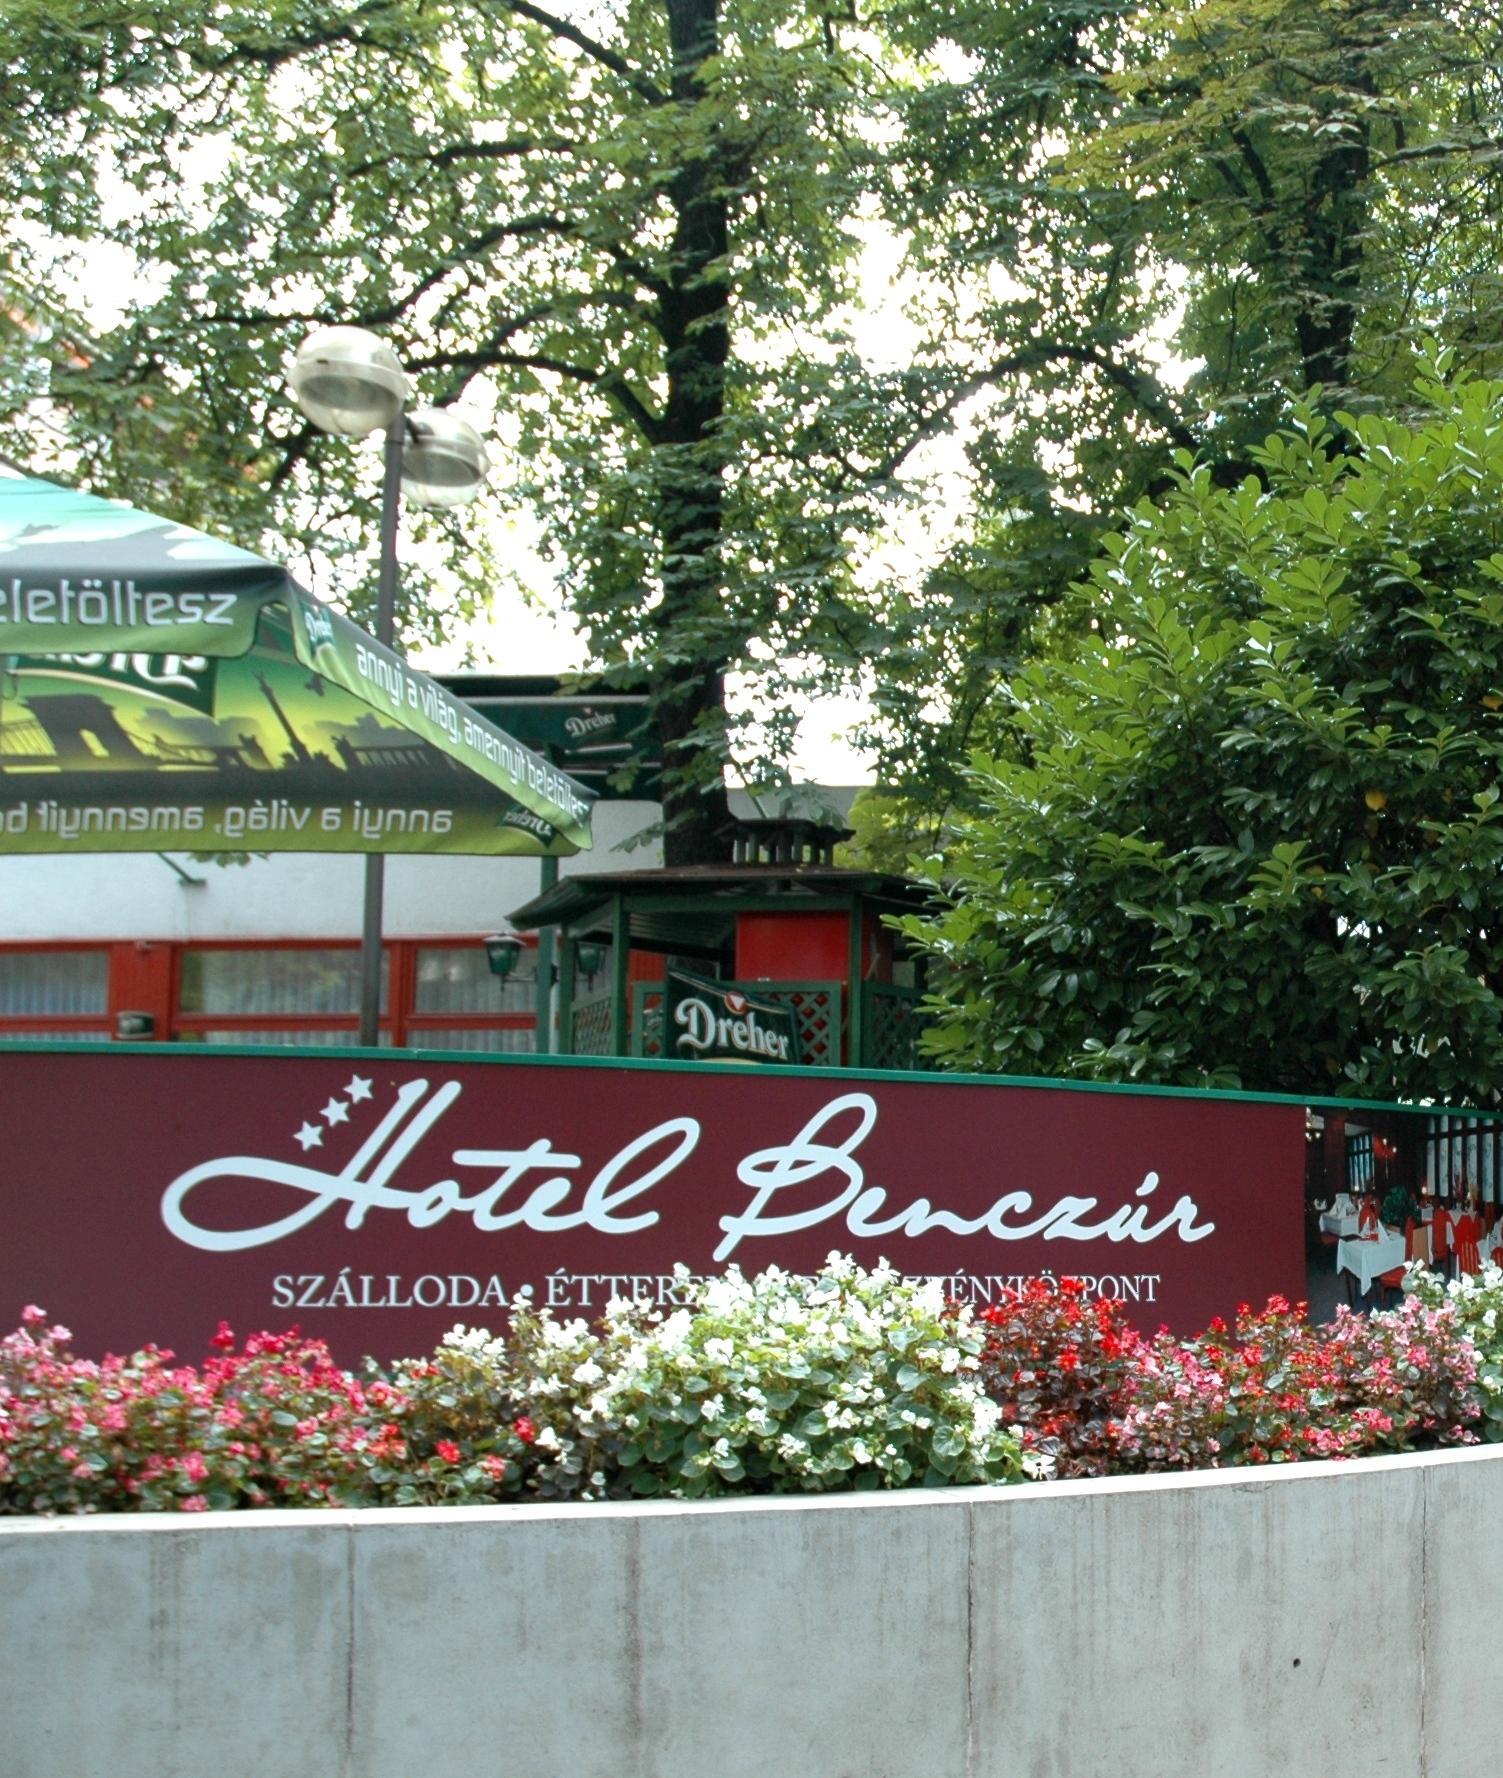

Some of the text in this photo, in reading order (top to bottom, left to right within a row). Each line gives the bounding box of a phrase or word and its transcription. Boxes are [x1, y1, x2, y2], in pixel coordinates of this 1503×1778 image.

[356, 643, 404, 707] annyi
[406, 677, 419, 709] a
[463, 717, 526, 785] amennyit
[673, 997, 790, 1061] Dreher
[160, 1078, 1216, 1263] Hotel Benczúr
[271, 1267, 510, 1309] SZÁLLODA
